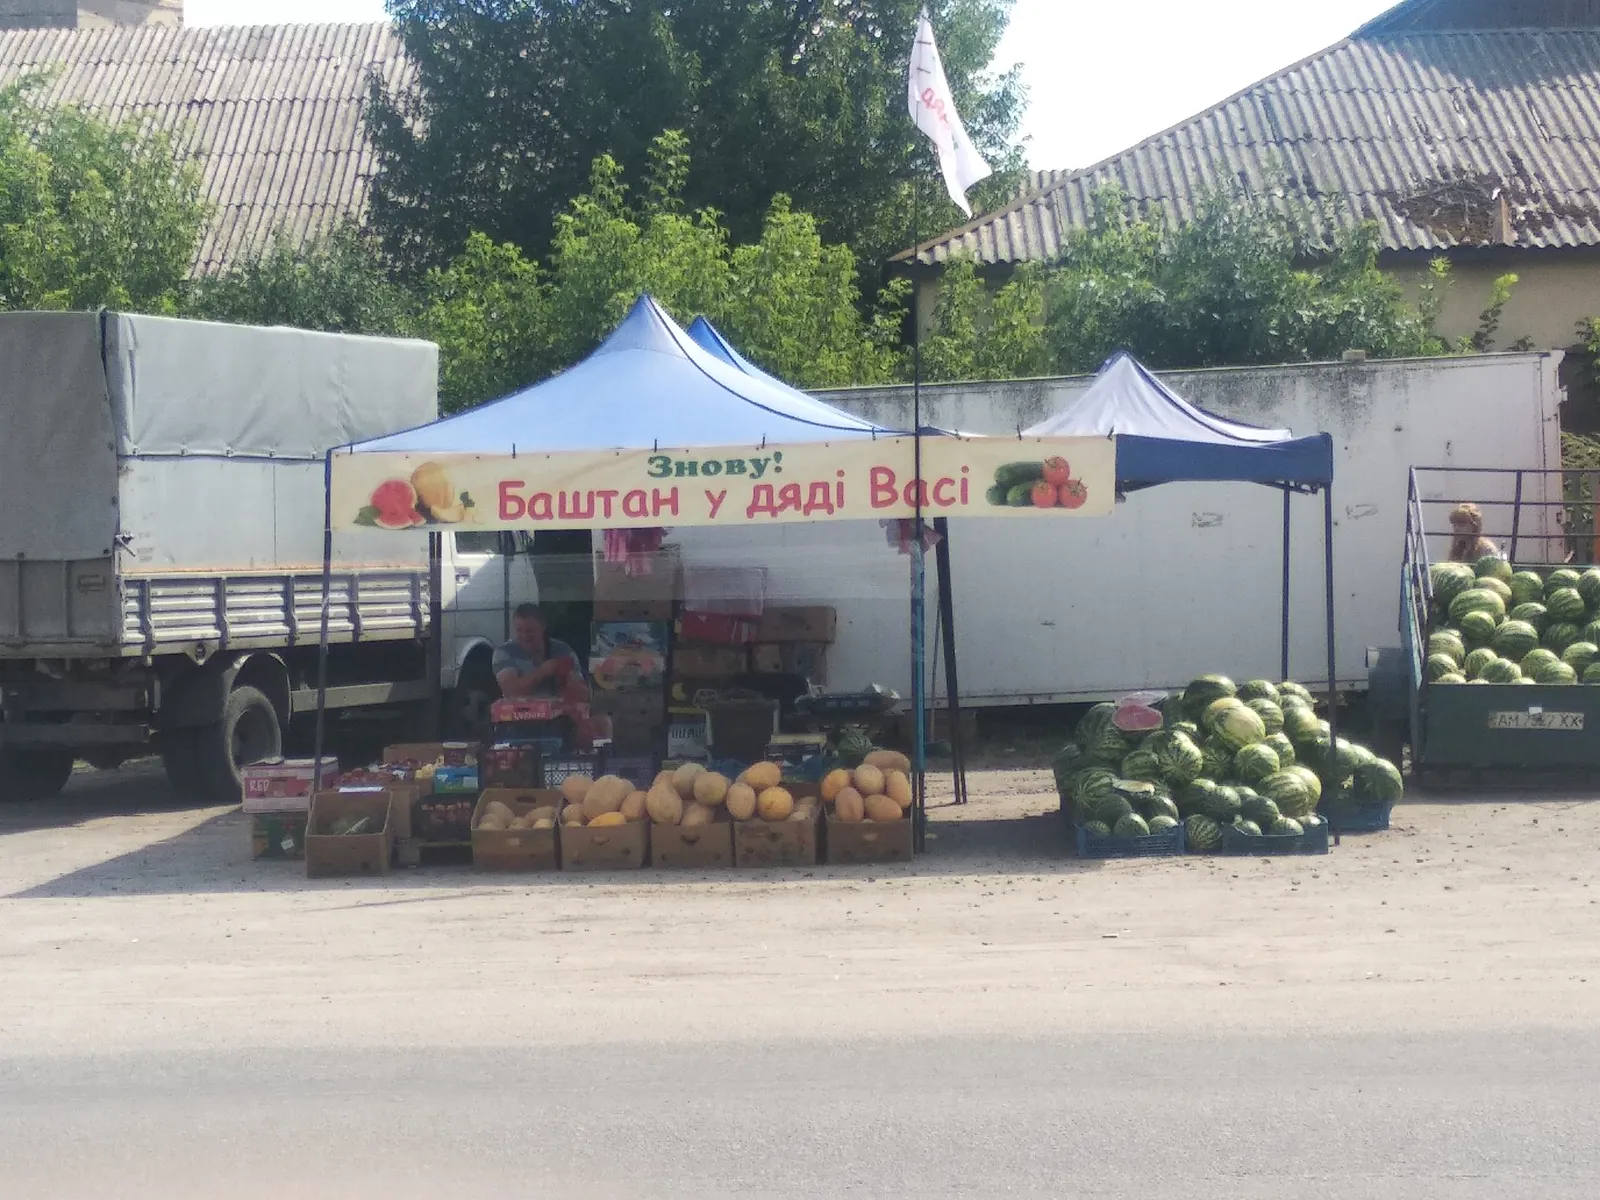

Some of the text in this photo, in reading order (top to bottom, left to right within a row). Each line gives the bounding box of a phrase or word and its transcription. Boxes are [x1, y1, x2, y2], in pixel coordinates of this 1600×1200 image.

[647, 451, 785, 480] Знову!
[498, 465, 970, 521] Баштан у дяді Васі
